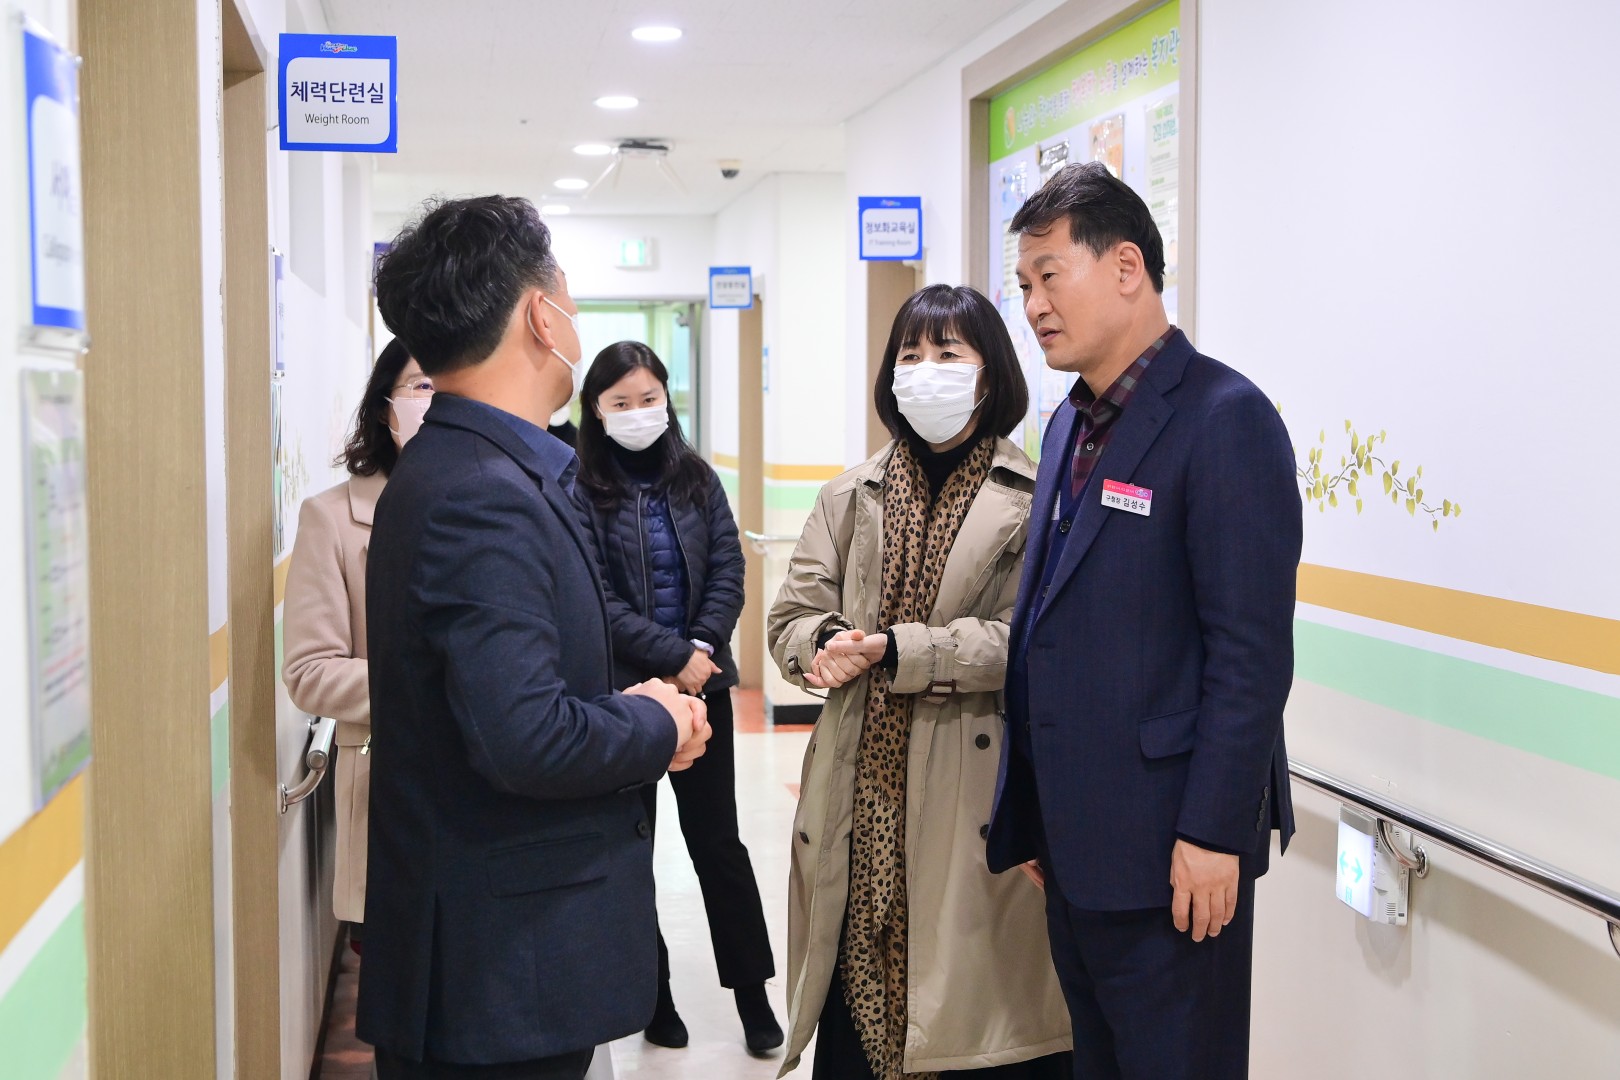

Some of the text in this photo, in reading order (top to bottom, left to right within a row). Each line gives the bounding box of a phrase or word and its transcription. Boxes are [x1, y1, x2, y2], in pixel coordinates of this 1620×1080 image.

[1151, 28, 1180, 68] 복지관
[290, 81, 384, 104] 체력단련실
[305, 113, 370, 126] Weight Room
[866, 221, 915, 234] 정보화교육실
[1123, 497, 1146, 511] 김성수
